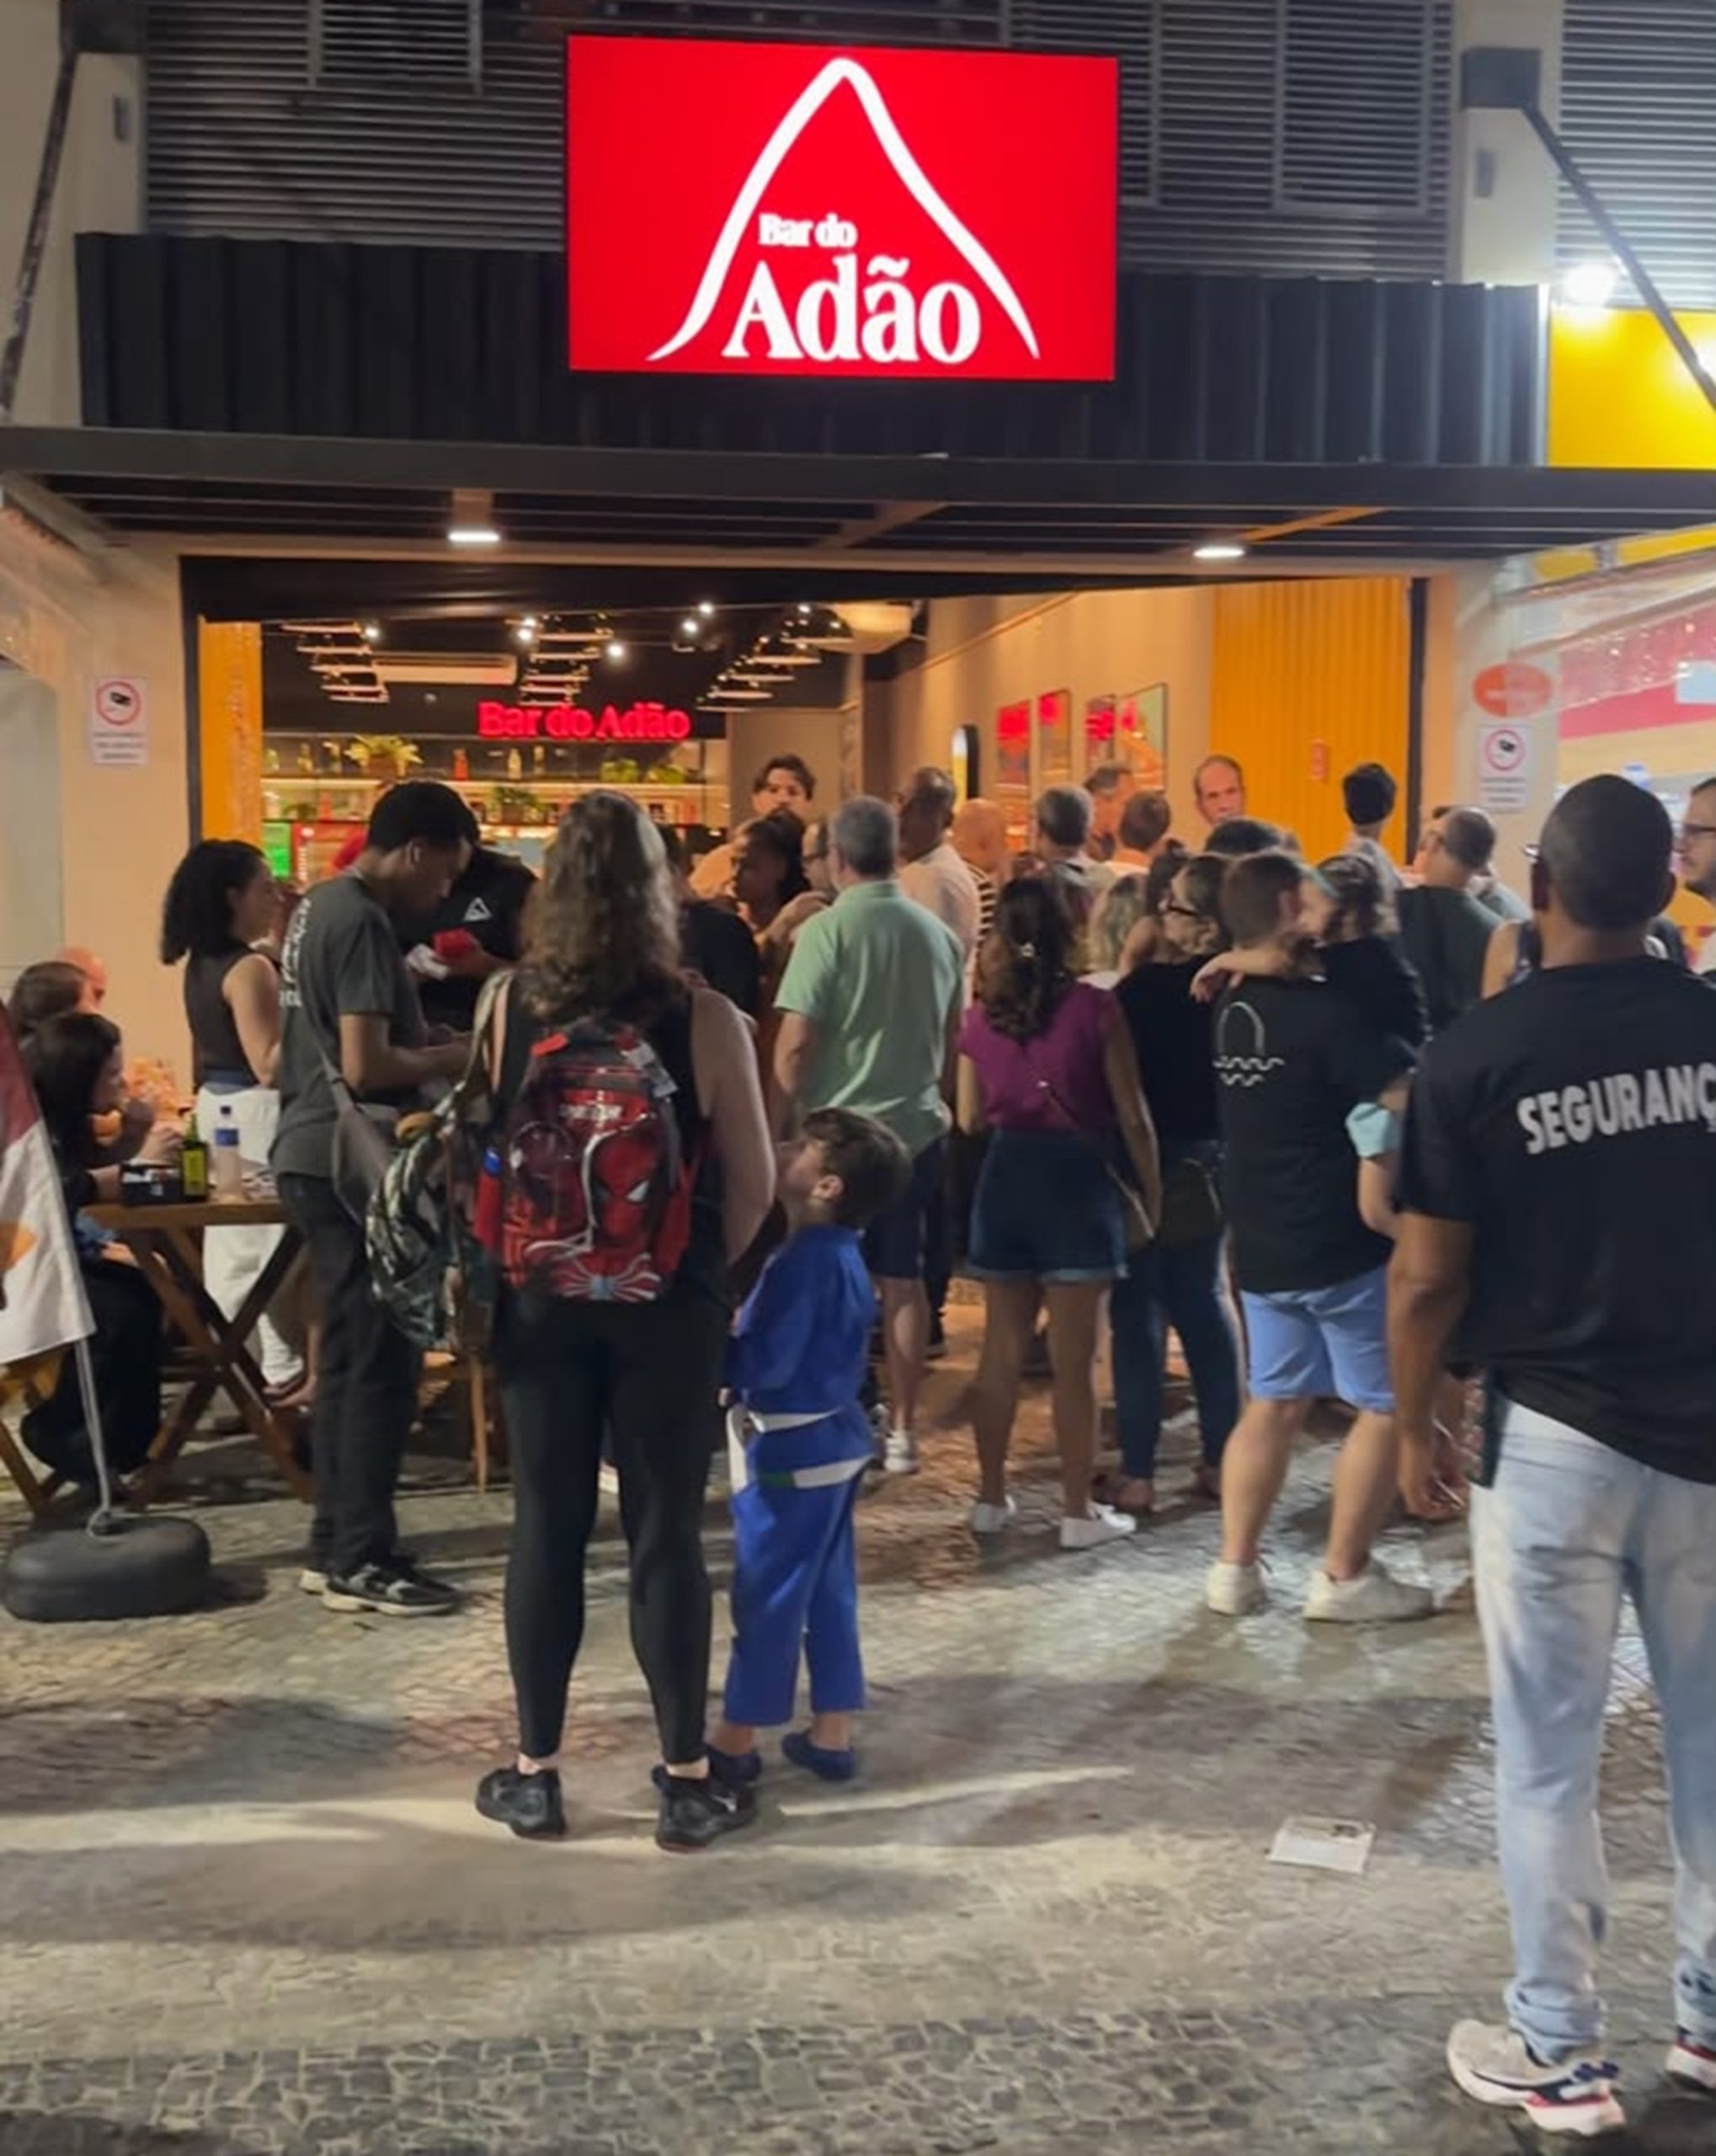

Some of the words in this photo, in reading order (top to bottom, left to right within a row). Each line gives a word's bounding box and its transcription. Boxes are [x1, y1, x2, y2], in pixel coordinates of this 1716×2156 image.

[759, 213, 814, 247] Bar
[815, 212, 858, 248] do
[721, 252, 982, 364] Adão
[477, 701, 542, 738] Bar
[545, 702, 594, 738] do
[594, 702, 690, 739] Adão
